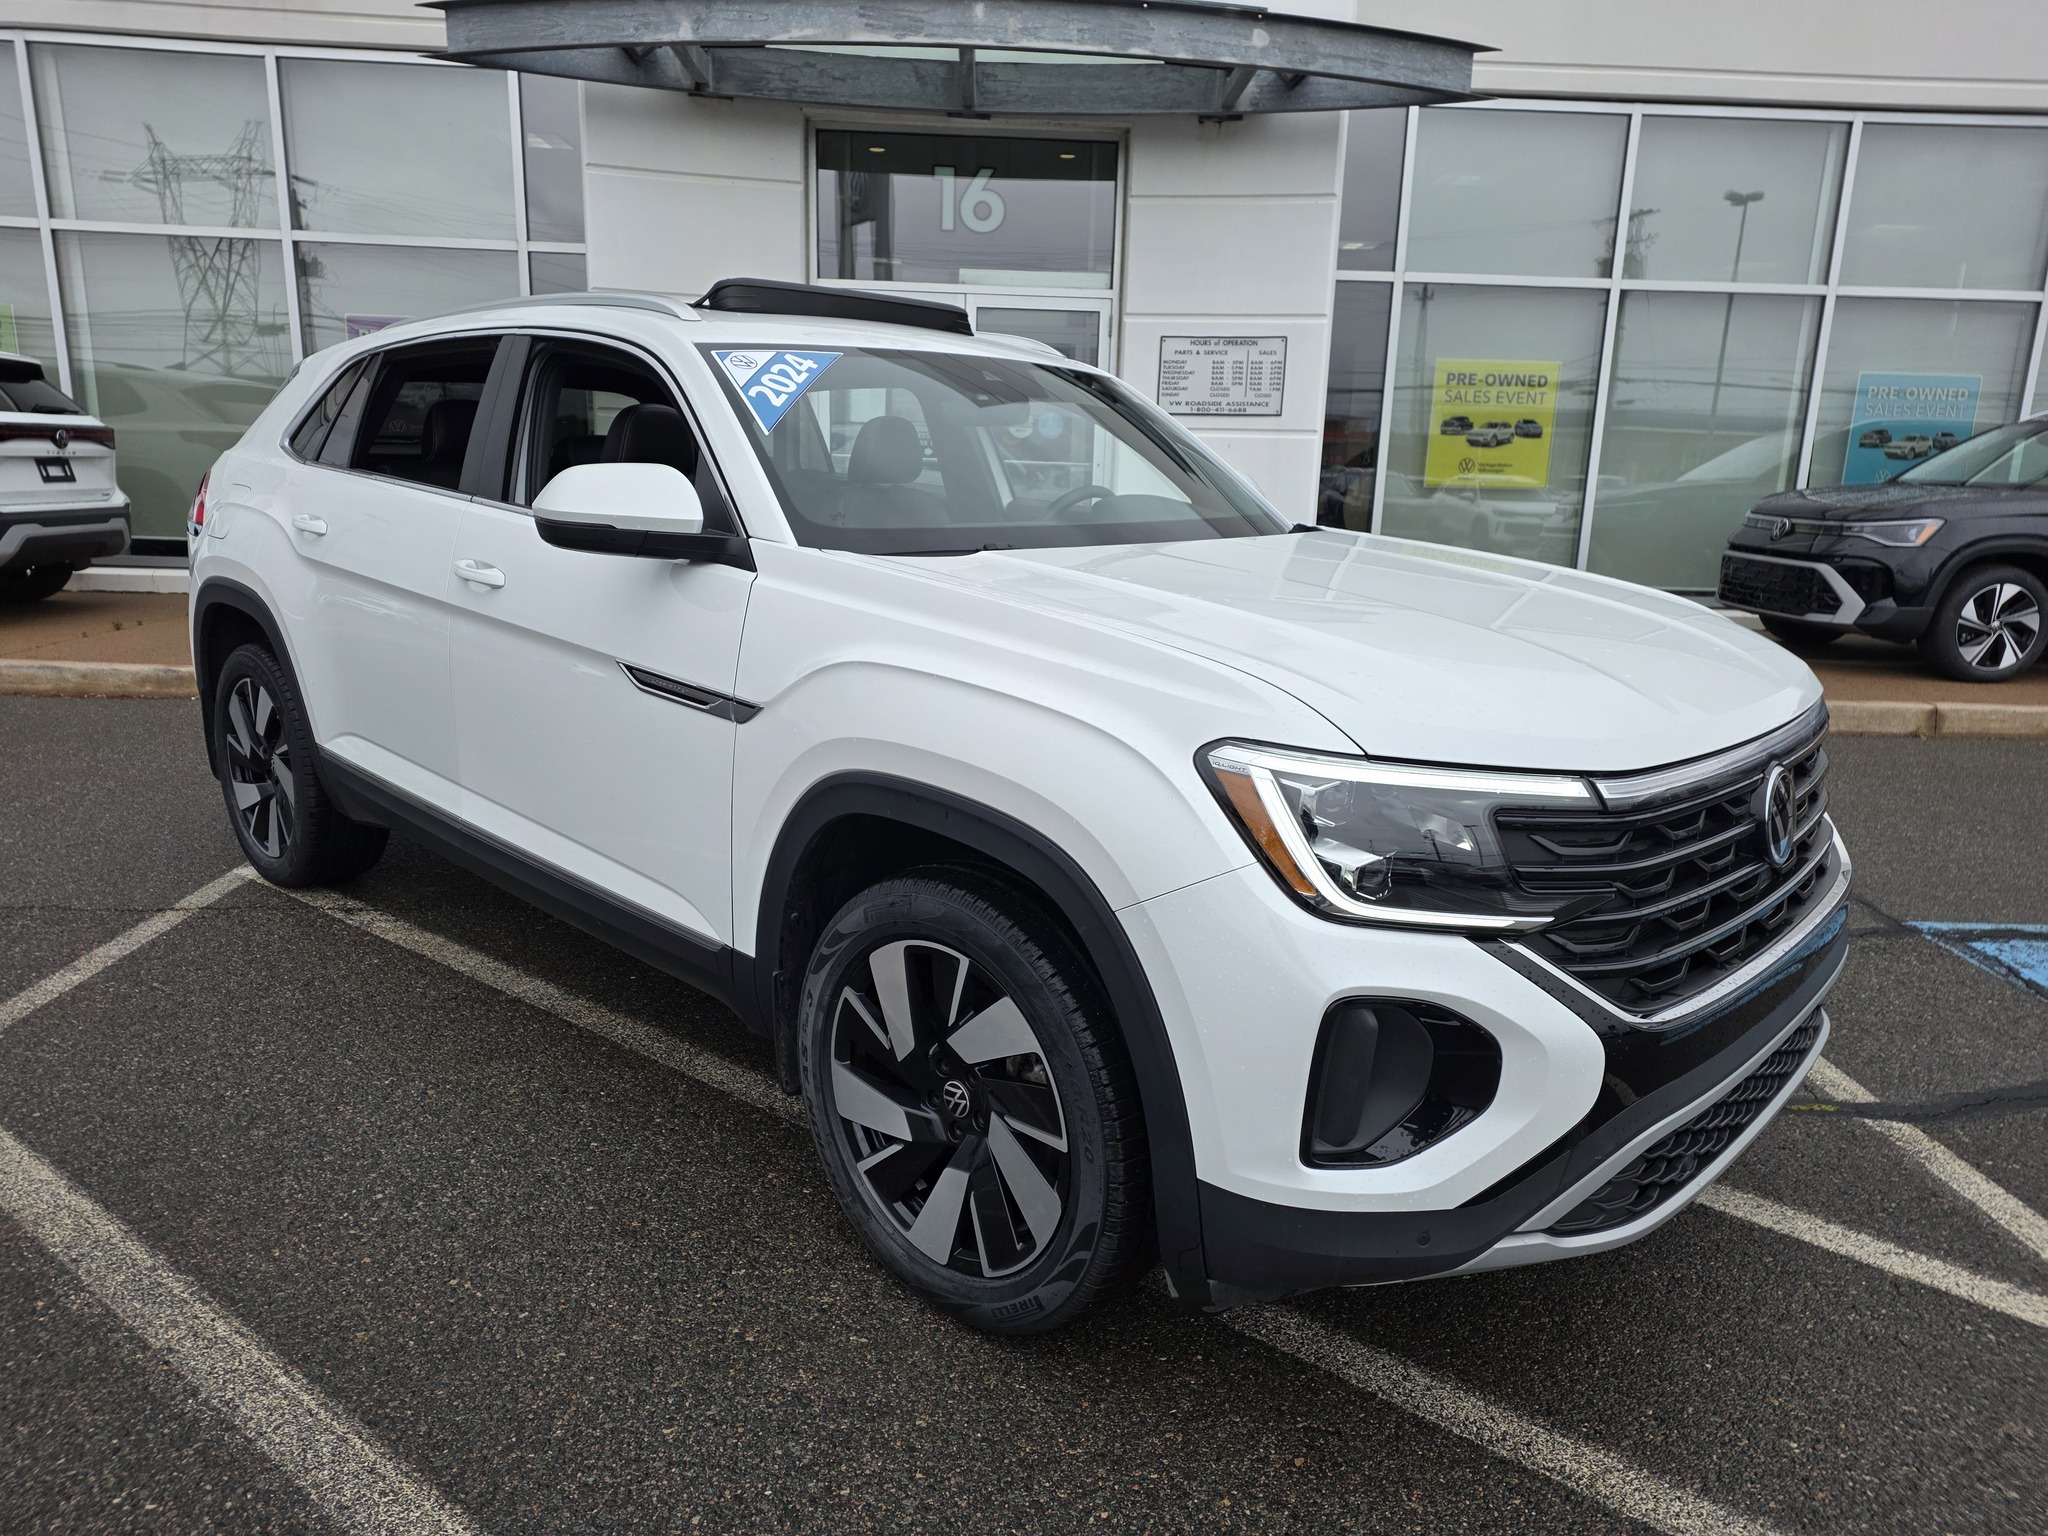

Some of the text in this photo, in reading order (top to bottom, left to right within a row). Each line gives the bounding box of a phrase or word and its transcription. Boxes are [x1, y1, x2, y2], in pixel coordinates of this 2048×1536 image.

[934, 166, 1005, 233] 16
[748, 353, 818, 407] 2024
[1446, 372, 1549, 388] PRE-OWNED
[1444, 389, 1547, 405] SALES EVENT
[1865, 402, 1965, 418] SALES EVENT
[1458, 457, 1475, 475] VW
